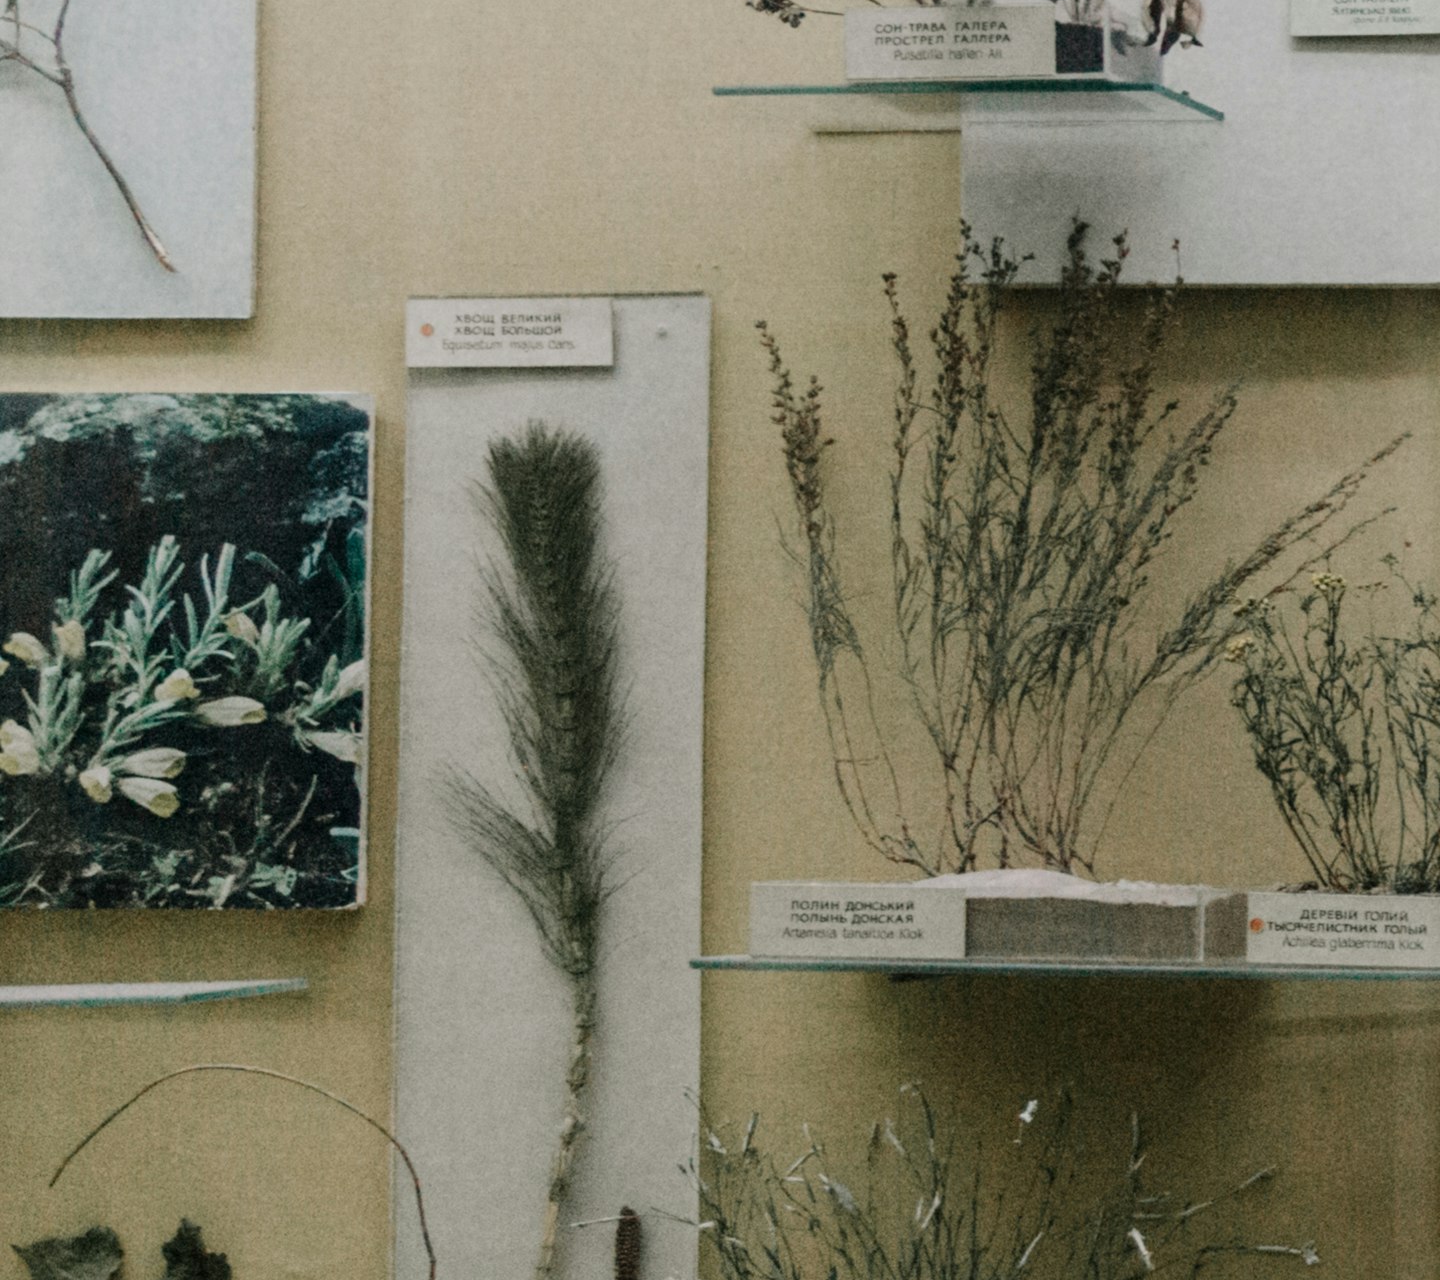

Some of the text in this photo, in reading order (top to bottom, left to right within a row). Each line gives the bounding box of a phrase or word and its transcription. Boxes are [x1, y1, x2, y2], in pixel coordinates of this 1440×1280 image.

[875, 23, 946, 34] СОН-ТРАВА
[875, 34, 1011, 46] ПРОСТРЕЛ ГАЛЛЕРА
[455, 313, 562, 325] ХВОЩ ВЕЛИКИЙ
[455, 325, 562, 337] ХВОЩ БОЛЬШОЙ
[791, 900, 914, 911] ПОЛИН ДОНСЬКИЙ
[791, 913, 914, 925] ПОЛЫНЬ ДОНСКАЯ
[1300, 909, 1409, 922] ДЕРЕВІЙ ГОЛИЙ
[1267, 921, 1428, 935] ТЫСЯЧЕЛИСТНИК ГОЛЫЙ
